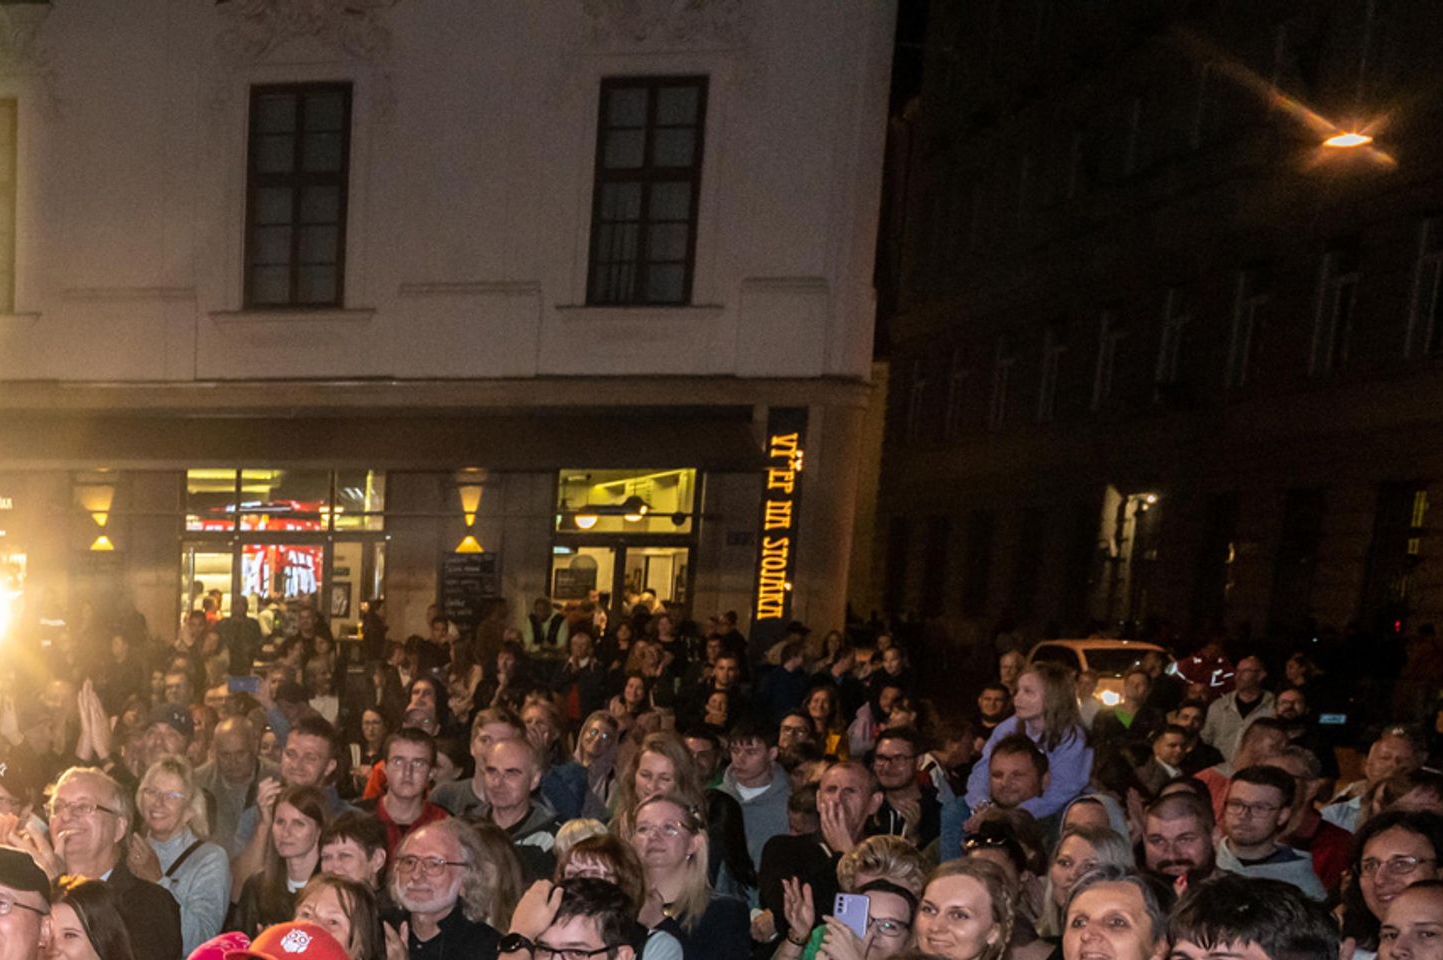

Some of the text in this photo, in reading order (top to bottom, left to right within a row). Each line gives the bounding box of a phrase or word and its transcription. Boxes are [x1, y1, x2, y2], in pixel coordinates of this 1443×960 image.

[756, 433, 804, 621] VÝEP NA STOJÁKA
